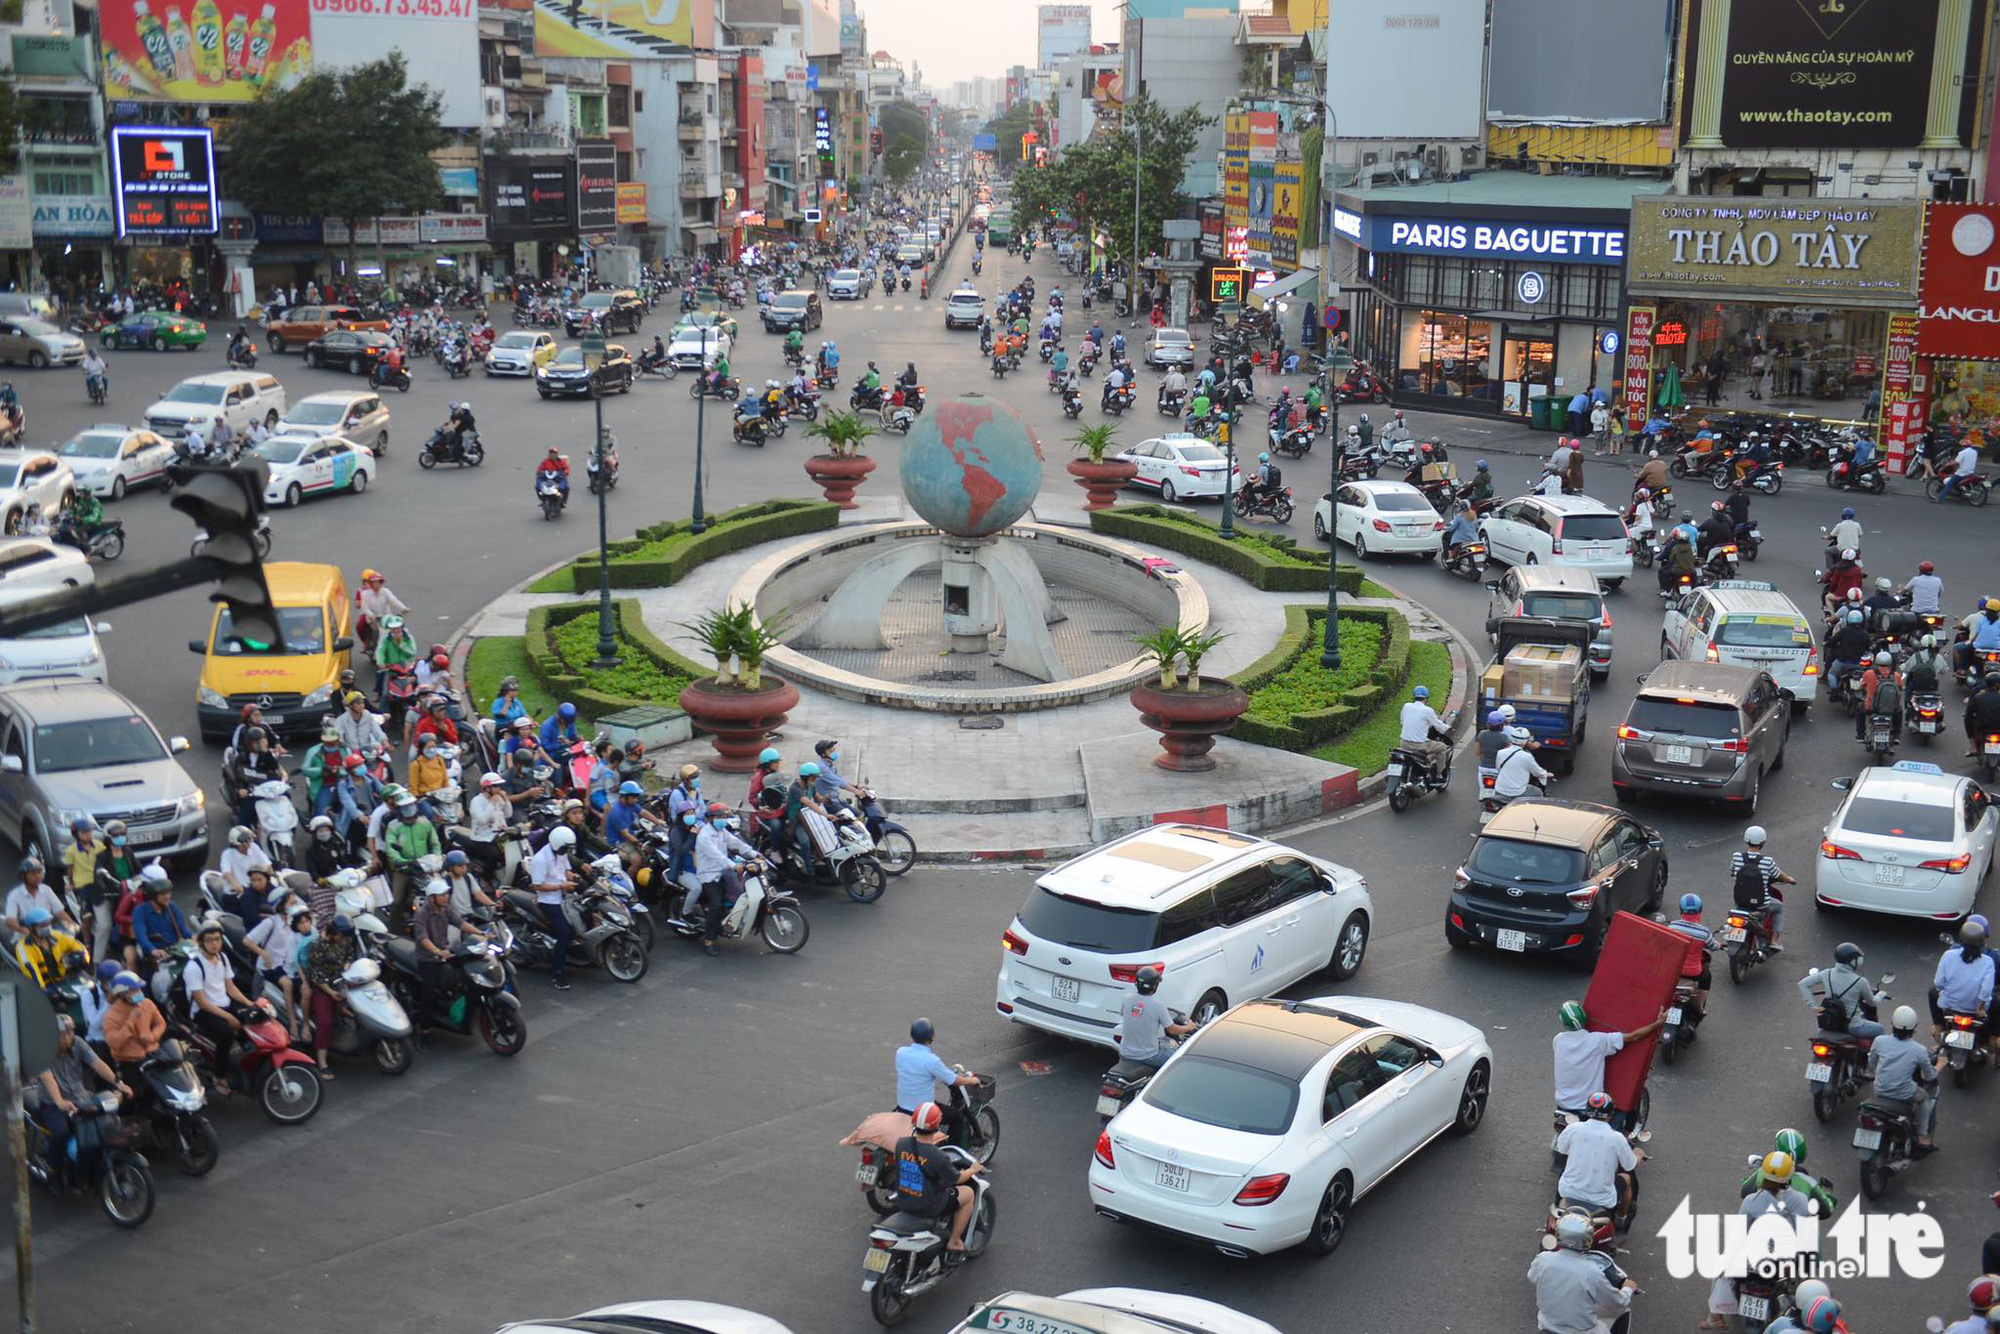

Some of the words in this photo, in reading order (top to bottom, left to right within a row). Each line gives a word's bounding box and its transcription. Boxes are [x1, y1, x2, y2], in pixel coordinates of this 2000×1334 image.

[1733, 51, 1774, 65] QUYỀN
[1776, 51, 1810, 64] NĂNG
[1811, 50, 1835, 63] CỦA
[1837, 52, 1856, 66] SỰ
[1857, 50, 1892, 63] HOÀN
[1895, 50, 1915, 63] MỸ
[1739, 108, 1892, 125] www.thaotay.com
[33, 207, 60, 221] AN
[67, 202, 111, 222] HÒA
[1661, 204, 1693, 218] CÔNG
[1695, 208, 1708, 218] TY
[1712, 207, 1741, 218] TNHH
[1392, 222, 1467, 250] PARIS
[1474, 226, 1625, 257] BAGUETTE
[1668, 220, 1780, 267] THẢO
[1791, 223, 1869, 269] TÂY
[1628, 373, 1646, 389] NỐI
[1627, 389, 1646, 403] TÓC
[1882, 864, 1899, 875] 51H
[1504, 930, 1519, 941] 51F
[1058, 978, 1073, 990] 62A
